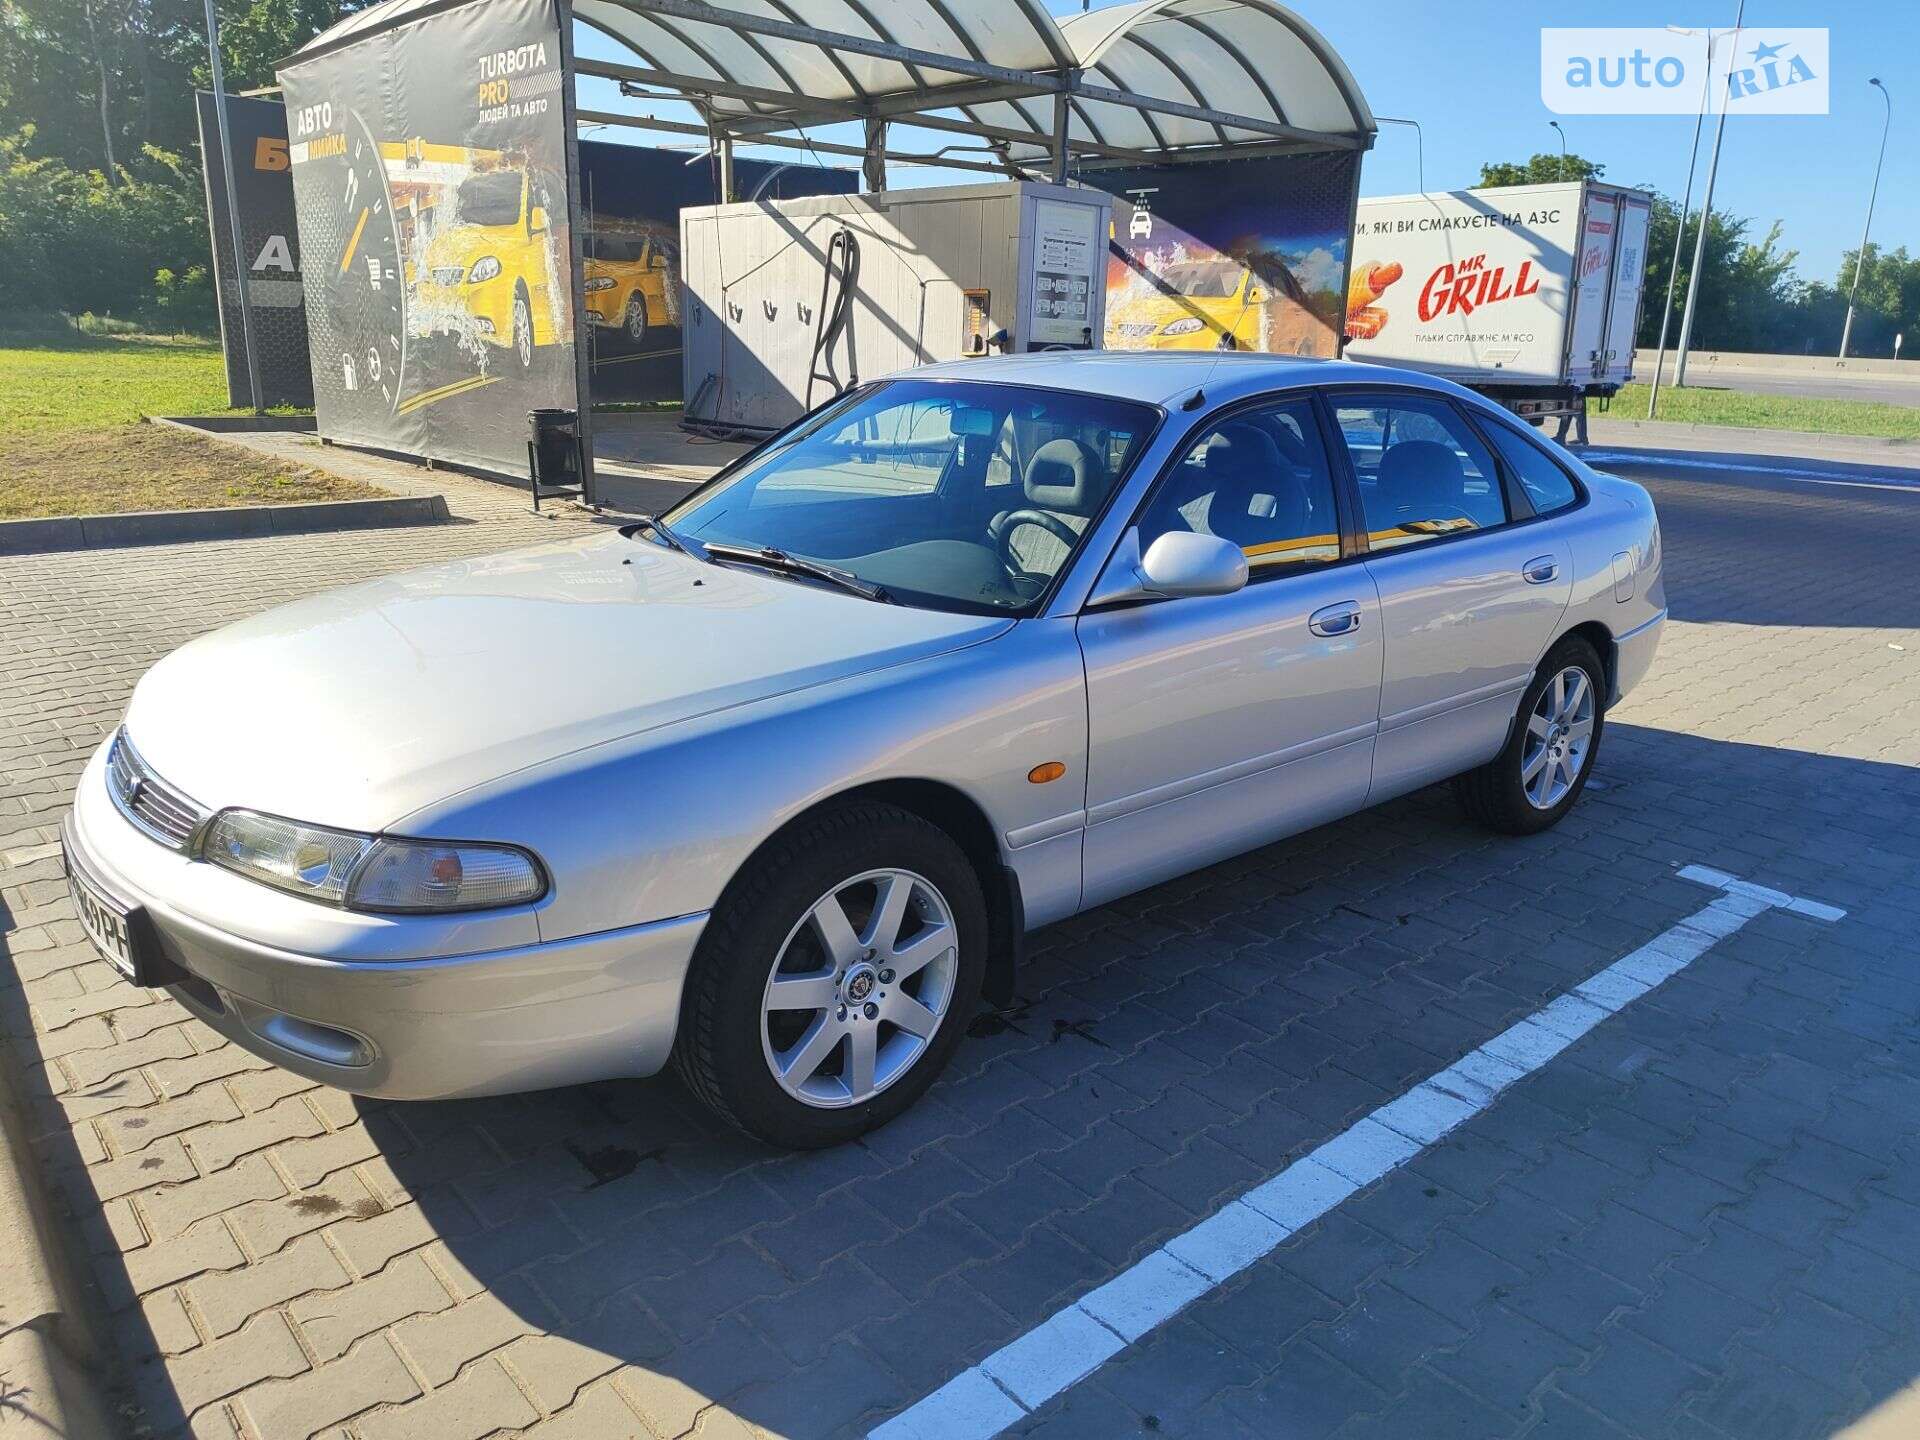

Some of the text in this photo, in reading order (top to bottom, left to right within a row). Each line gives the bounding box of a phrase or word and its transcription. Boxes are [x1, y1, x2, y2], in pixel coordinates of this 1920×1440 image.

[478, 42, 547, 80] TURBOTA
[478, 79, 509, 107] PRO
[297, 101, 332, 137] АВТО
[478, 99, 548, 124] ЛЮДЕЙ ТА АВТО
[308, 132, 347, 161] МИЙКА
[1373, 221, 1393, 234] ЯКІ
[1397, 219, 1414, 233] ВИ
[1418, 214, 1498, 231] СМАКУЄТЕ
[1501, 213, 1523, 226] НА
[1527, 210, 1561, 225] АЗС
[1458, 254, 1486, 273] MR
[1417, 260, 1540, 323] GRILL
[1446, 333, 1499, 343] СПРАВЖНЄ
